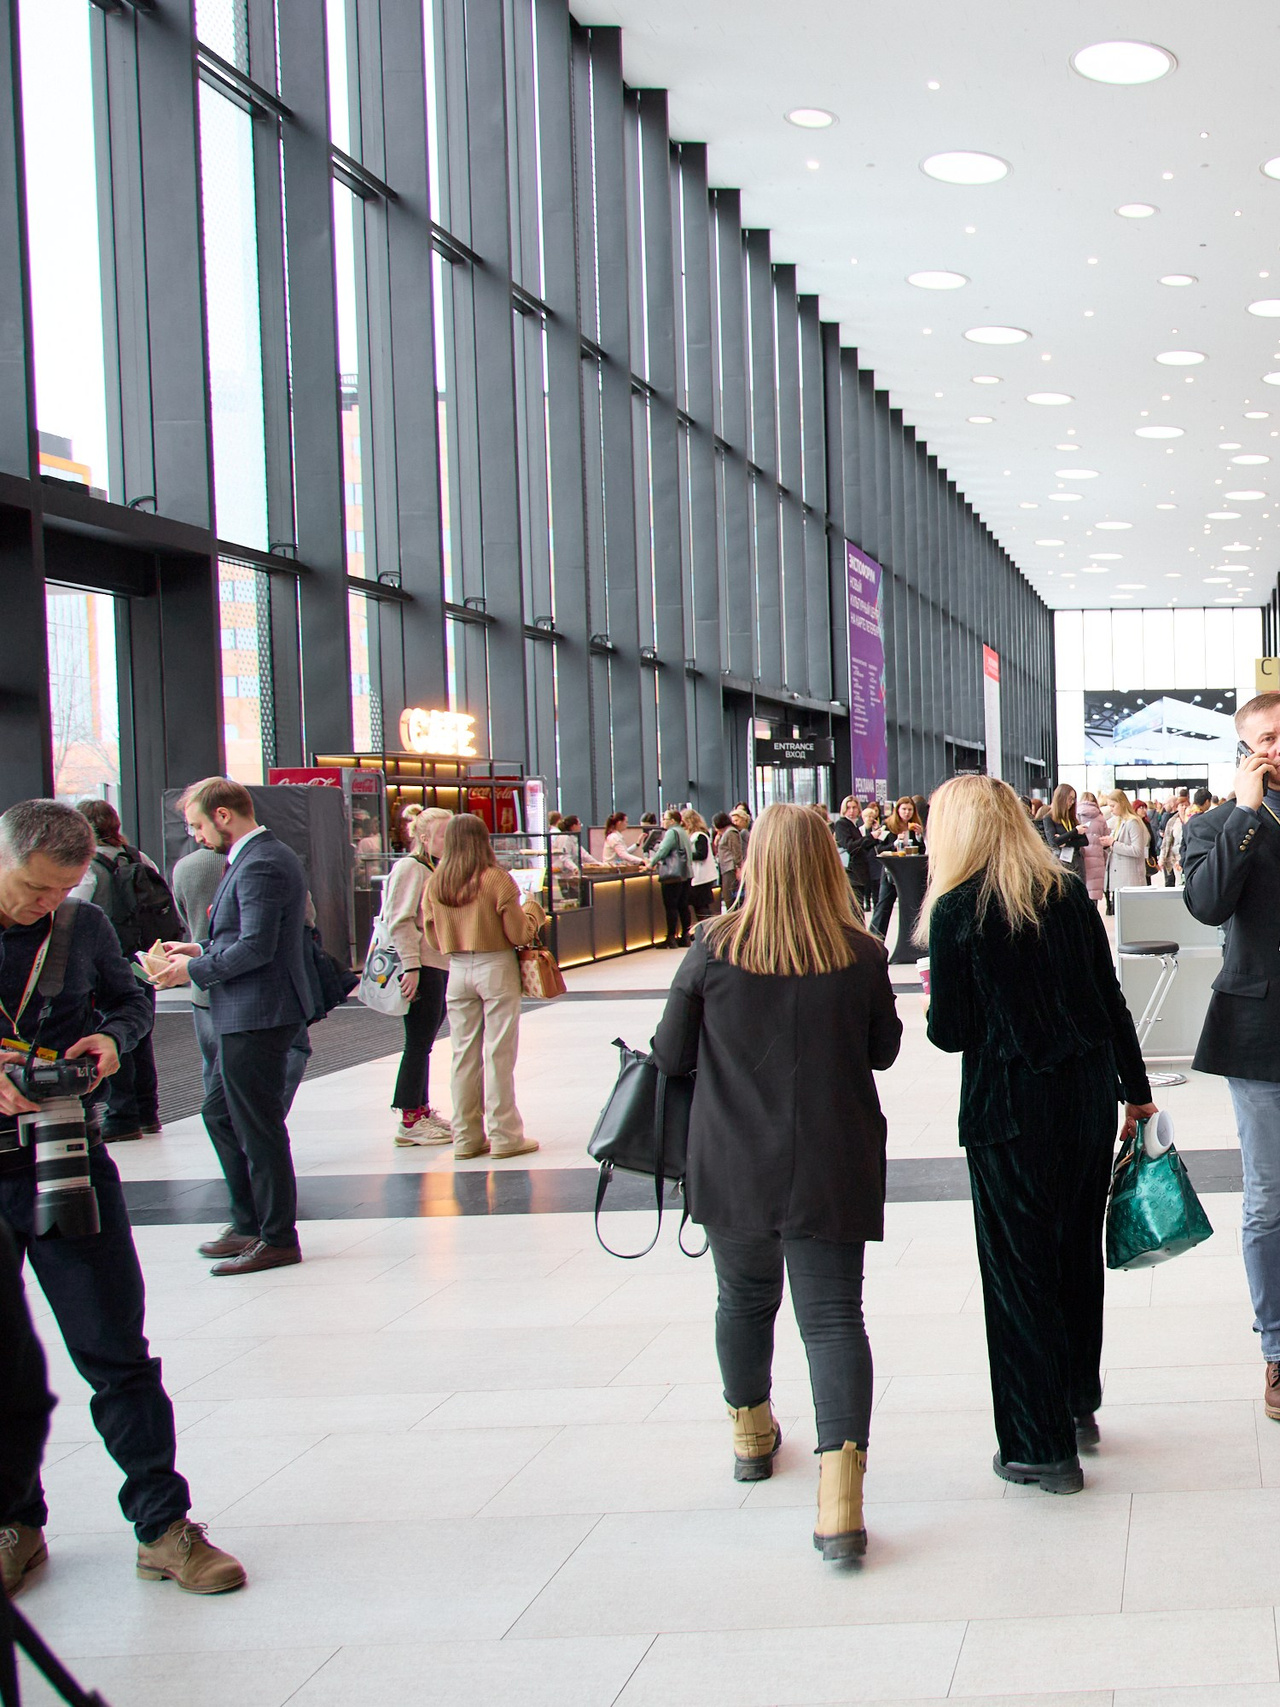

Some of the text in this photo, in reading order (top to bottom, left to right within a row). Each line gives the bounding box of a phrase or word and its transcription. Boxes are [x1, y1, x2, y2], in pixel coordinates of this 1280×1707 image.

[1261, 659, 1272, 675] C
[774, 743, 814, 751] ENTRANCE
[785, 751, 806, 759] ВХОД
